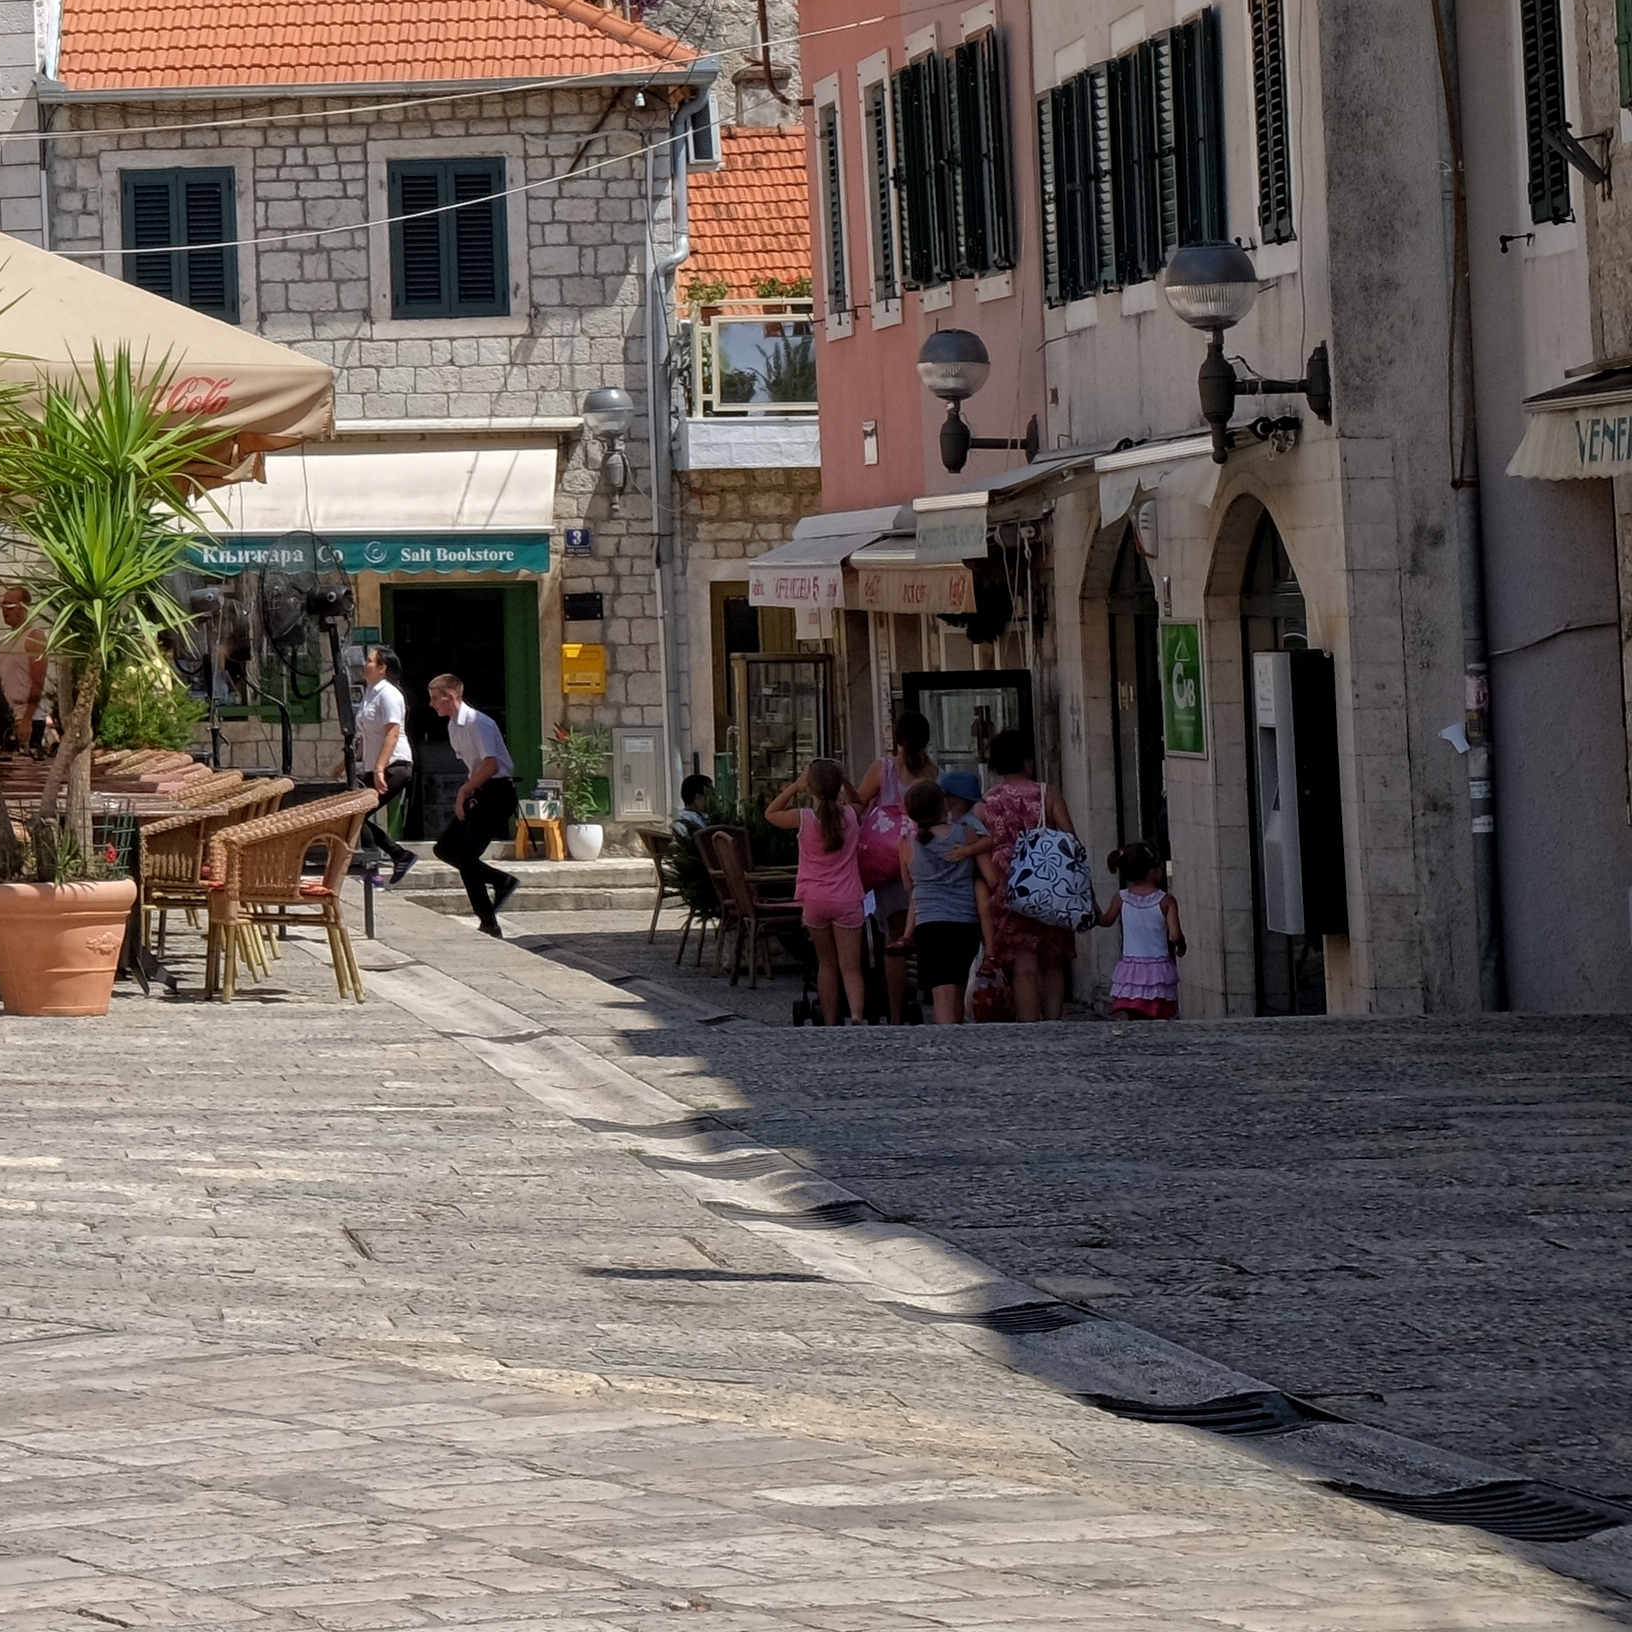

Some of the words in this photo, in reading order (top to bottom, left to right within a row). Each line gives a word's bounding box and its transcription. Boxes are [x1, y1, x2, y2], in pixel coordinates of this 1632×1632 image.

[572, 530, 582, 545] 3
[202, 545, 305, 568] Књижара
[400, 547, 432, 562] Salt
[436, 546, 515, 562] Bookstore
